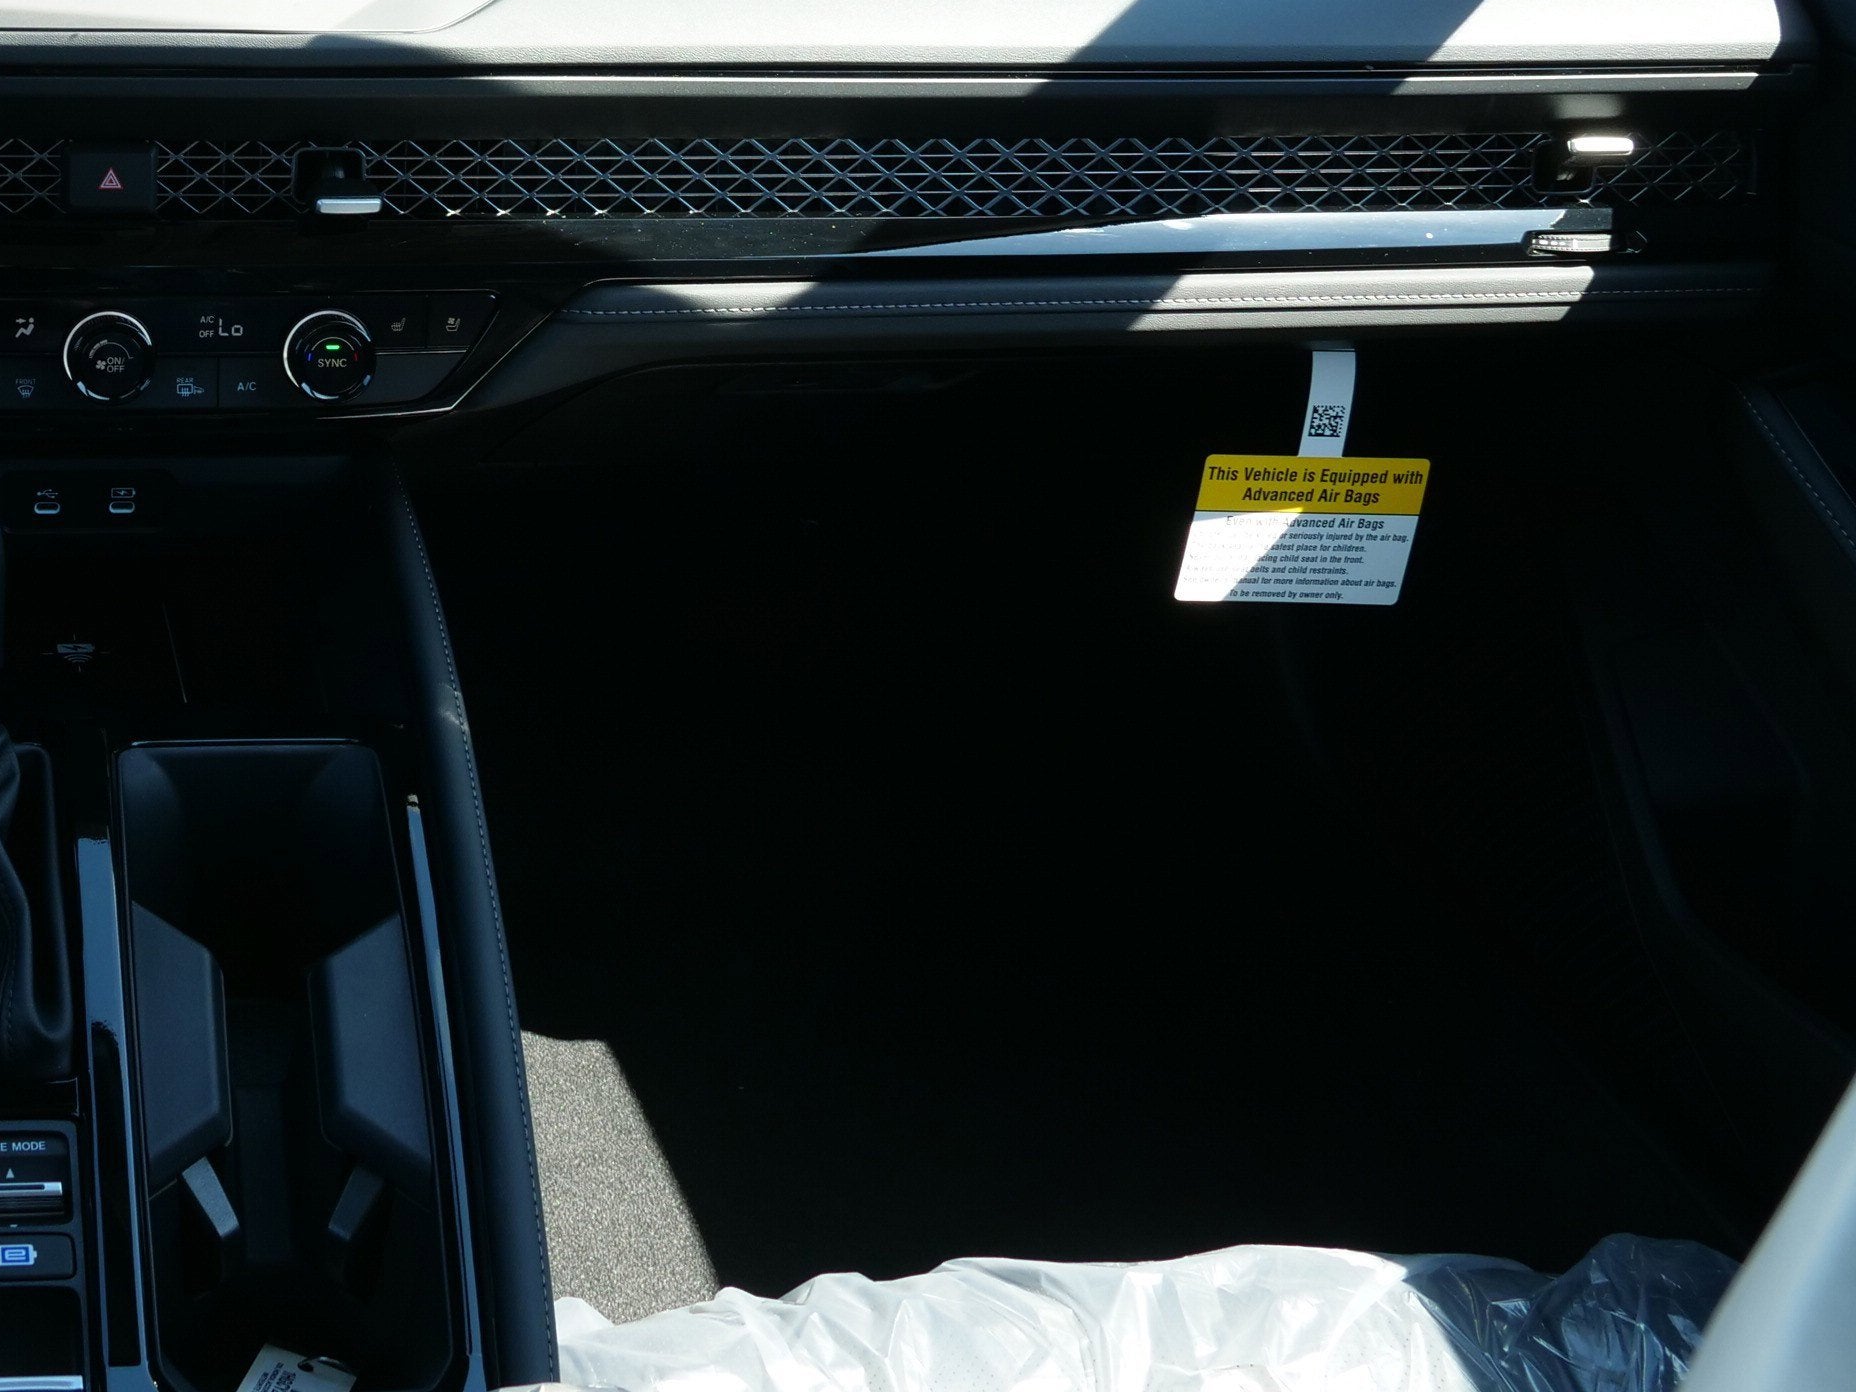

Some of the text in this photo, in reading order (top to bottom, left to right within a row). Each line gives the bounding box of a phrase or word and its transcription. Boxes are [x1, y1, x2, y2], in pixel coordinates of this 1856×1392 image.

[318, 359, 347, 368] SYNC
[107, 365, 125, 373] OFF
[237, 382, 256, 391] A/C
[1208, 466, 1423, 485] This Vehicle is Equipped with
[1242, 487, 1380, 505] Advanced Air Bags
[1338, 519, 1354, 528] Air
[1358, 519, 1385, 530] Bags
[1288, 532, 1324, 541] seriously
[1326, 533, 1353, 541] injured
[1355, 533, 1364, 542] by
[1392, 534, 1409, 543] bag.
[1296, 544, 1318, 553] place
[1320, 544, 1330, 552] for
[1333, 544, 1367, 552] children.
[1280, 555, 1299, 563] child
[1301, 555, 1318, 563] seat
[1271, 566, 1286, 574] and
[1288, 566, 1307, 574] child
[1309, 567, 1348, 575] restraints.
[1261, 577, 1271, 585] for
[1295, 577, 1338, 586] information
[1340, 578, 1362, 586] about
[1364, 579, 1375, 587] air
[1377, 579, 1397, 588] bags.
[1252, 590, 1286, 598] removed
[1288, 591, 1298, 599] by
[1325, 591, 1343, 599] only.
[12, 1141, 46, 1151] MODE
